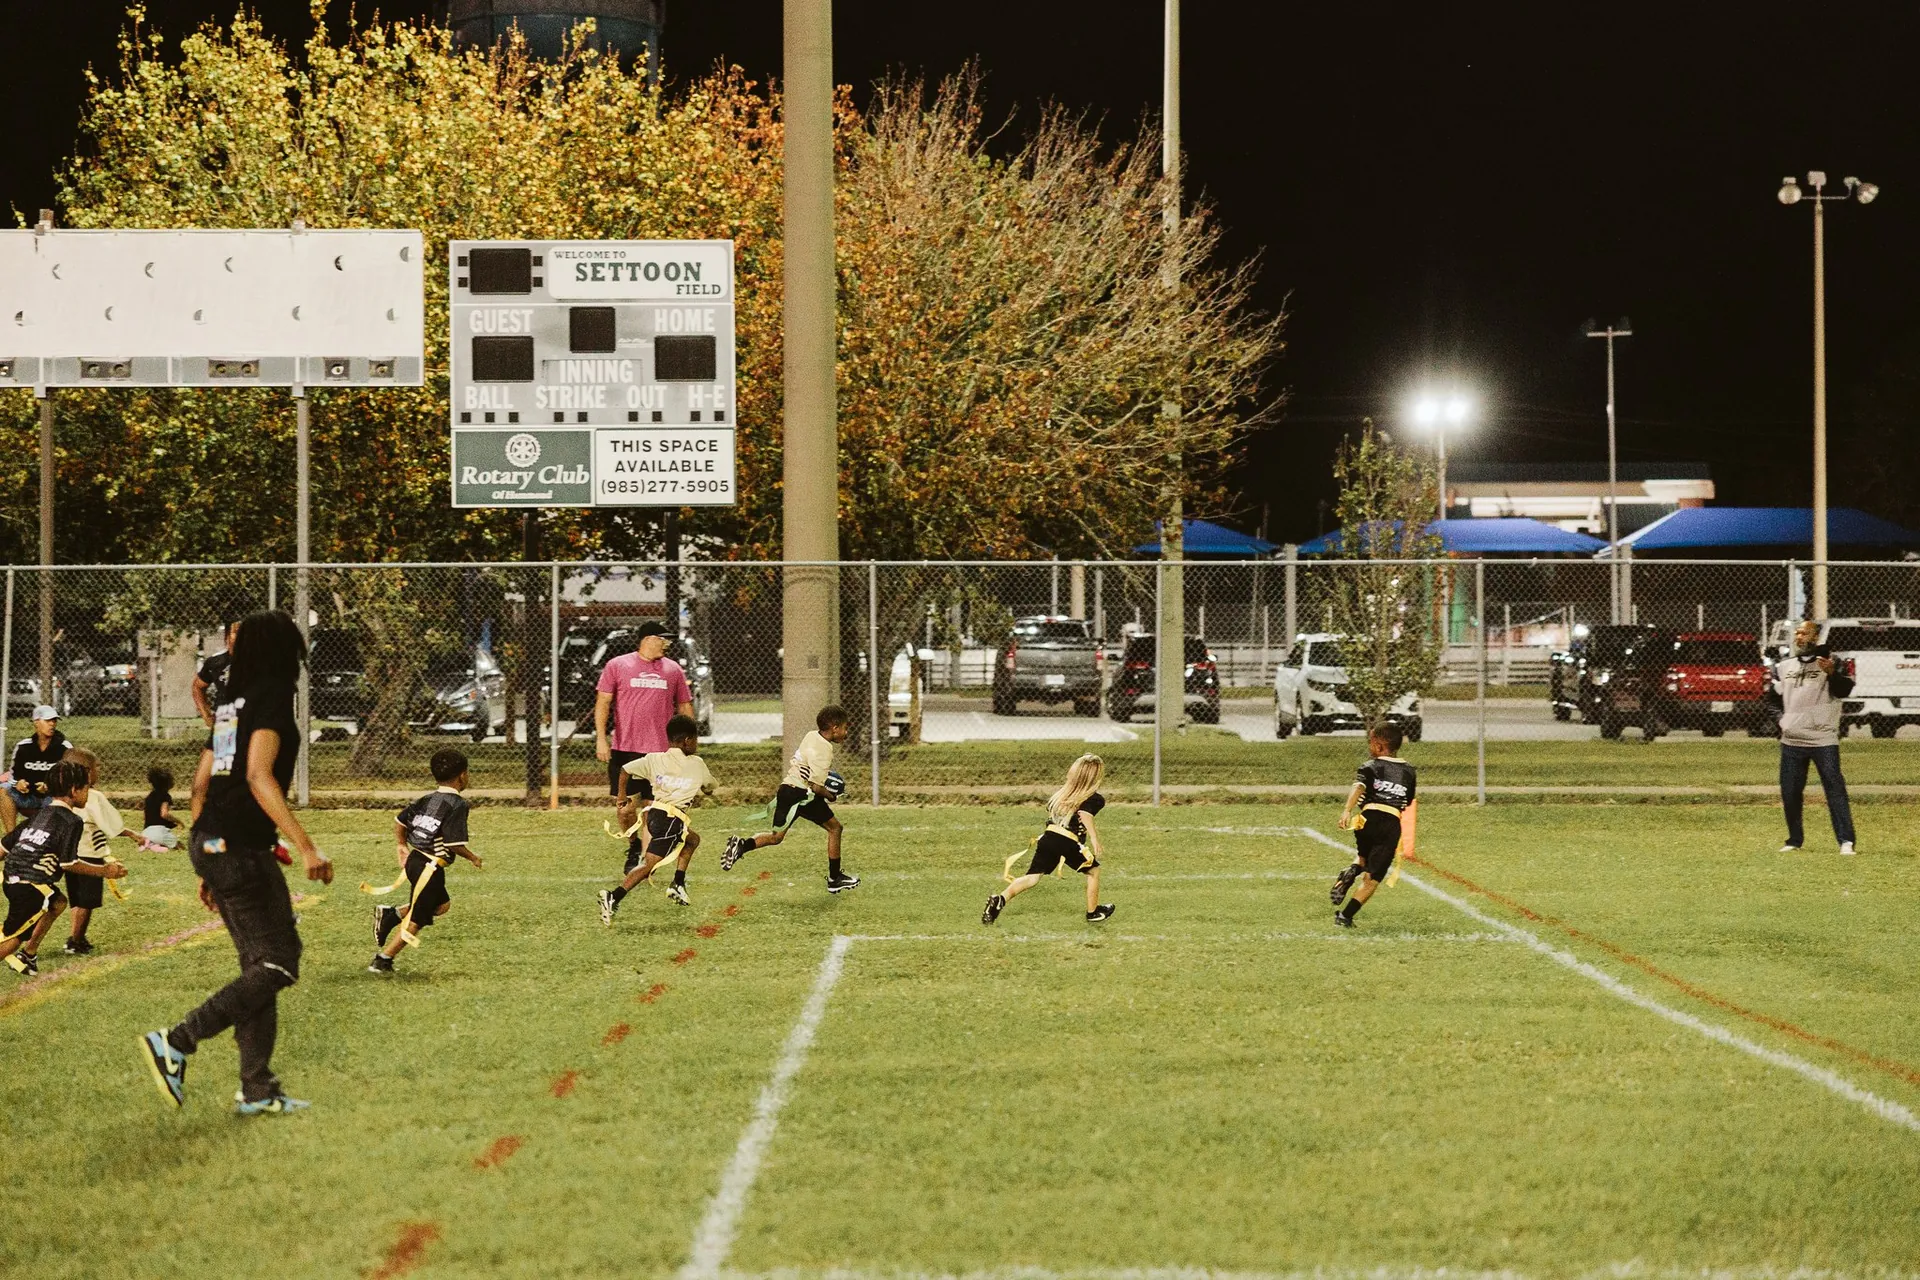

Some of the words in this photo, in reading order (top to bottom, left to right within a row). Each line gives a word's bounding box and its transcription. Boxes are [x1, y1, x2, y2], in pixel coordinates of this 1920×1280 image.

[554, 251, 611, 259] WELCOME
[612, 251, 627, 259] TO
[575, 262, 702, 282] SETTOON
[676, 284, 721, 295] FIELD
[469, 310, 534, 333] GUEST
[654, 309, 716, 332] HOME
[559, 360, 634, 383] INNING
[465, 386, 514, 409] BALL
[535, 385, 607, 409] STRIKE
[626, 385, 667, 409] OUT
[688, 385, 725, 408] H-E
[610, 440, 653, 452] THIS
[659, 440, 718, 452] SPACE
[614, 460, 714, 472] AVAILABLE
[460, 466, 535, 489] Rotary
[538, 465, 590, 485] Club
